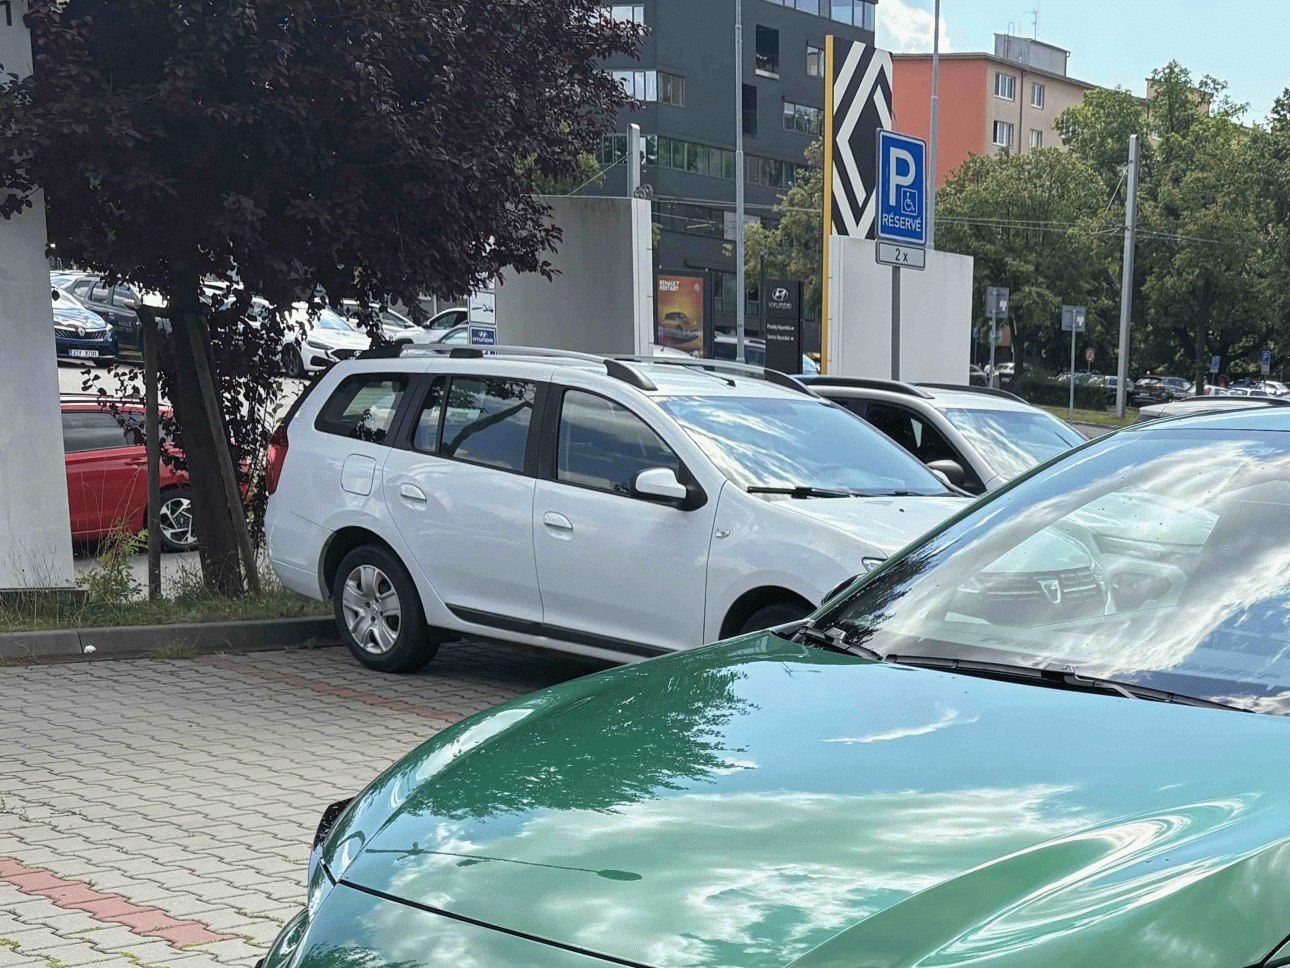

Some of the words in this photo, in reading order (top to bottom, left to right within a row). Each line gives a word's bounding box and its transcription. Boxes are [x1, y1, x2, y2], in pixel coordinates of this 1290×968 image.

[888, 146, 916, 207] P
[882, 212, 922, 232] RÉSERVÉ
[895, 248, 901, 261] 2
